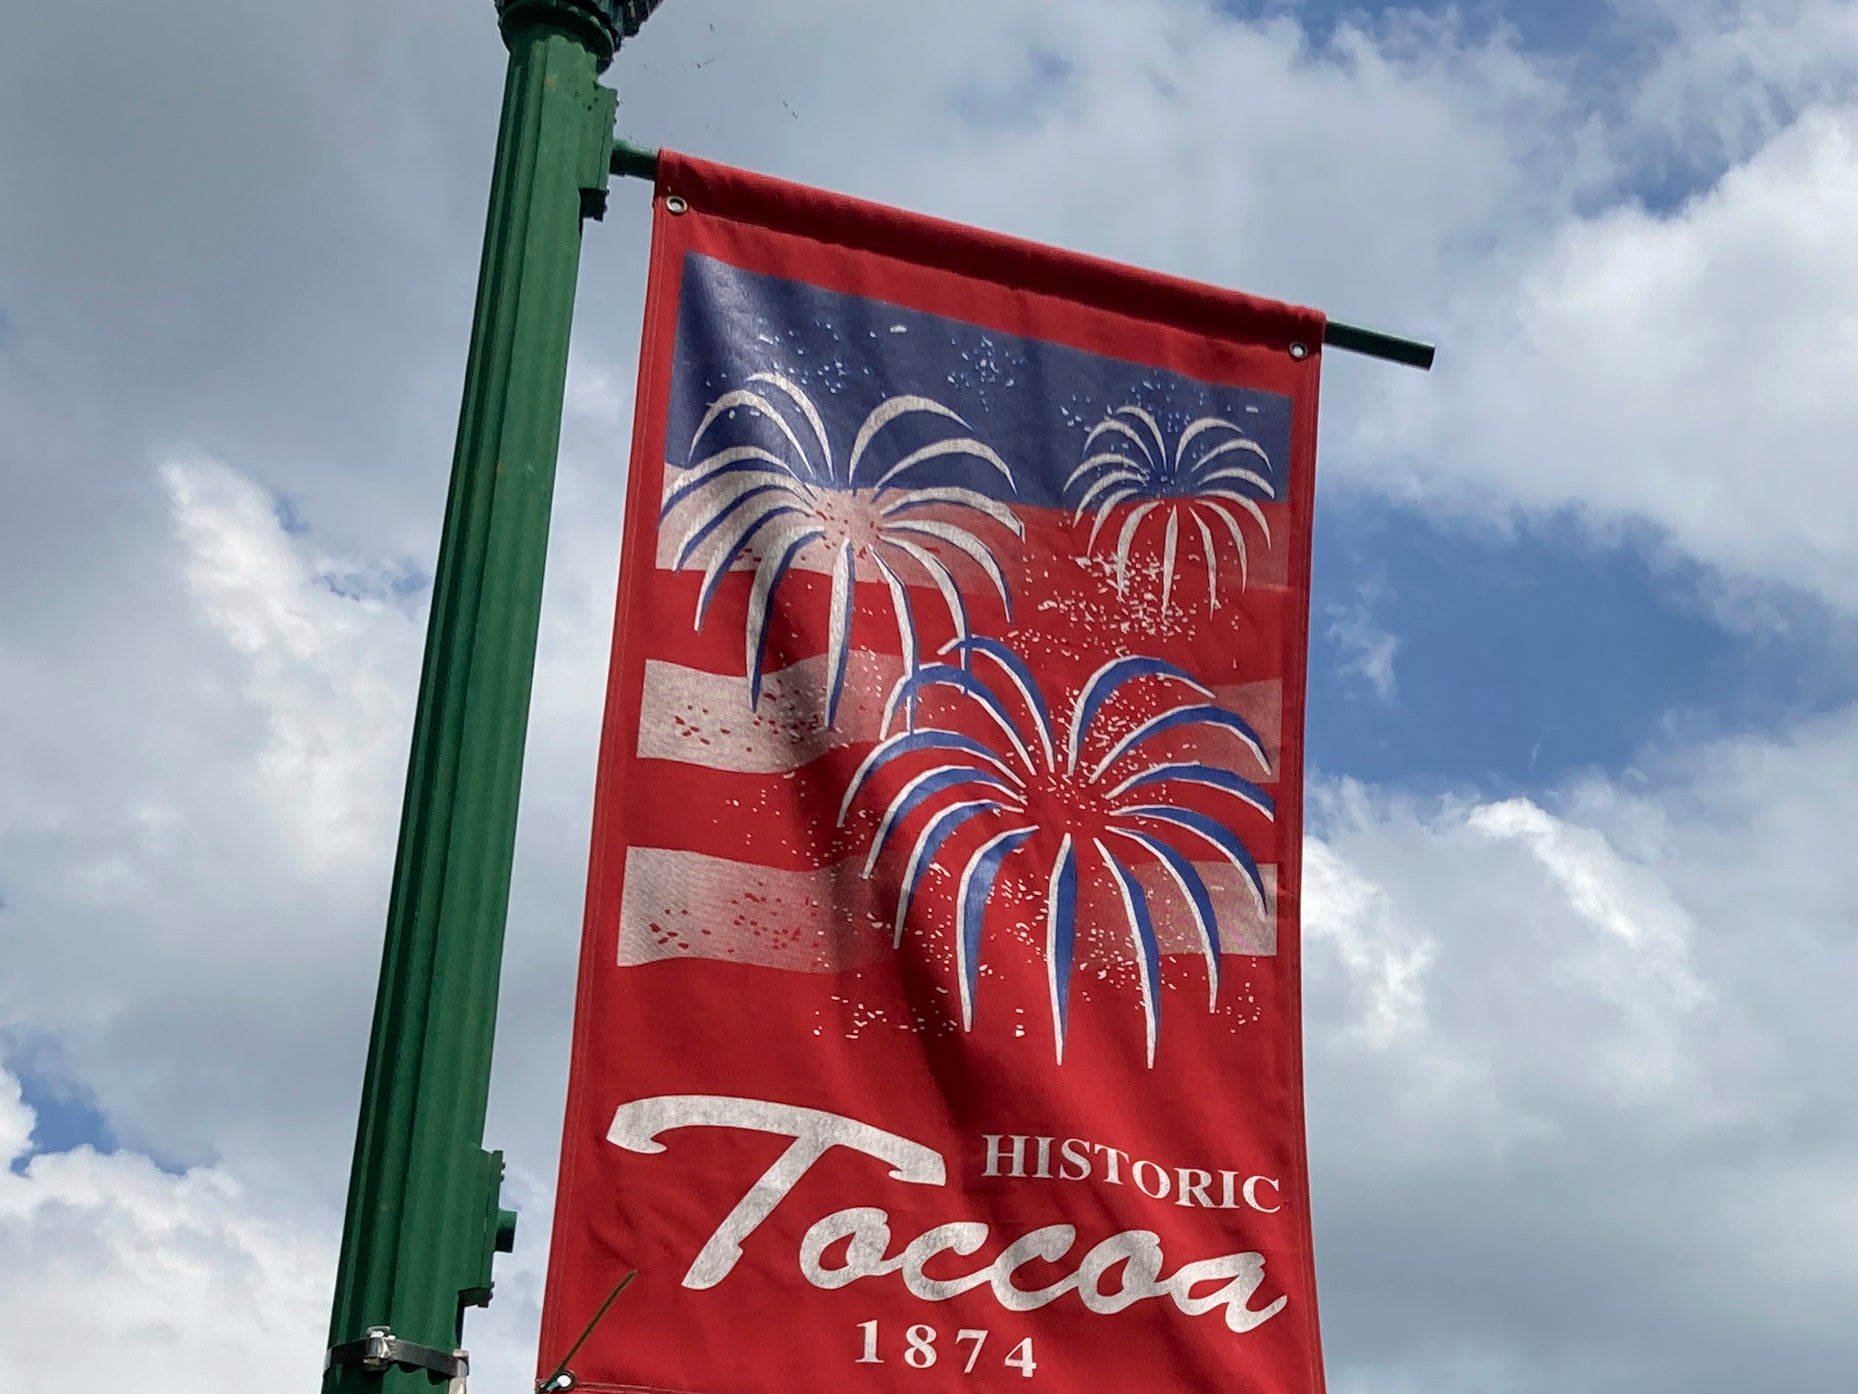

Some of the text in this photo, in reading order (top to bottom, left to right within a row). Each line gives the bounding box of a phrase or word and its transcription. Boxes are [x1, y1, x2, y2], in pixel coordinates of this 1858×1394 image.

[605, 1094, 1288, 1333] Toccoa
[981, 1133, 1281, 1214] HISTORIC
[855, 1319, 1038, 1378] 1874
